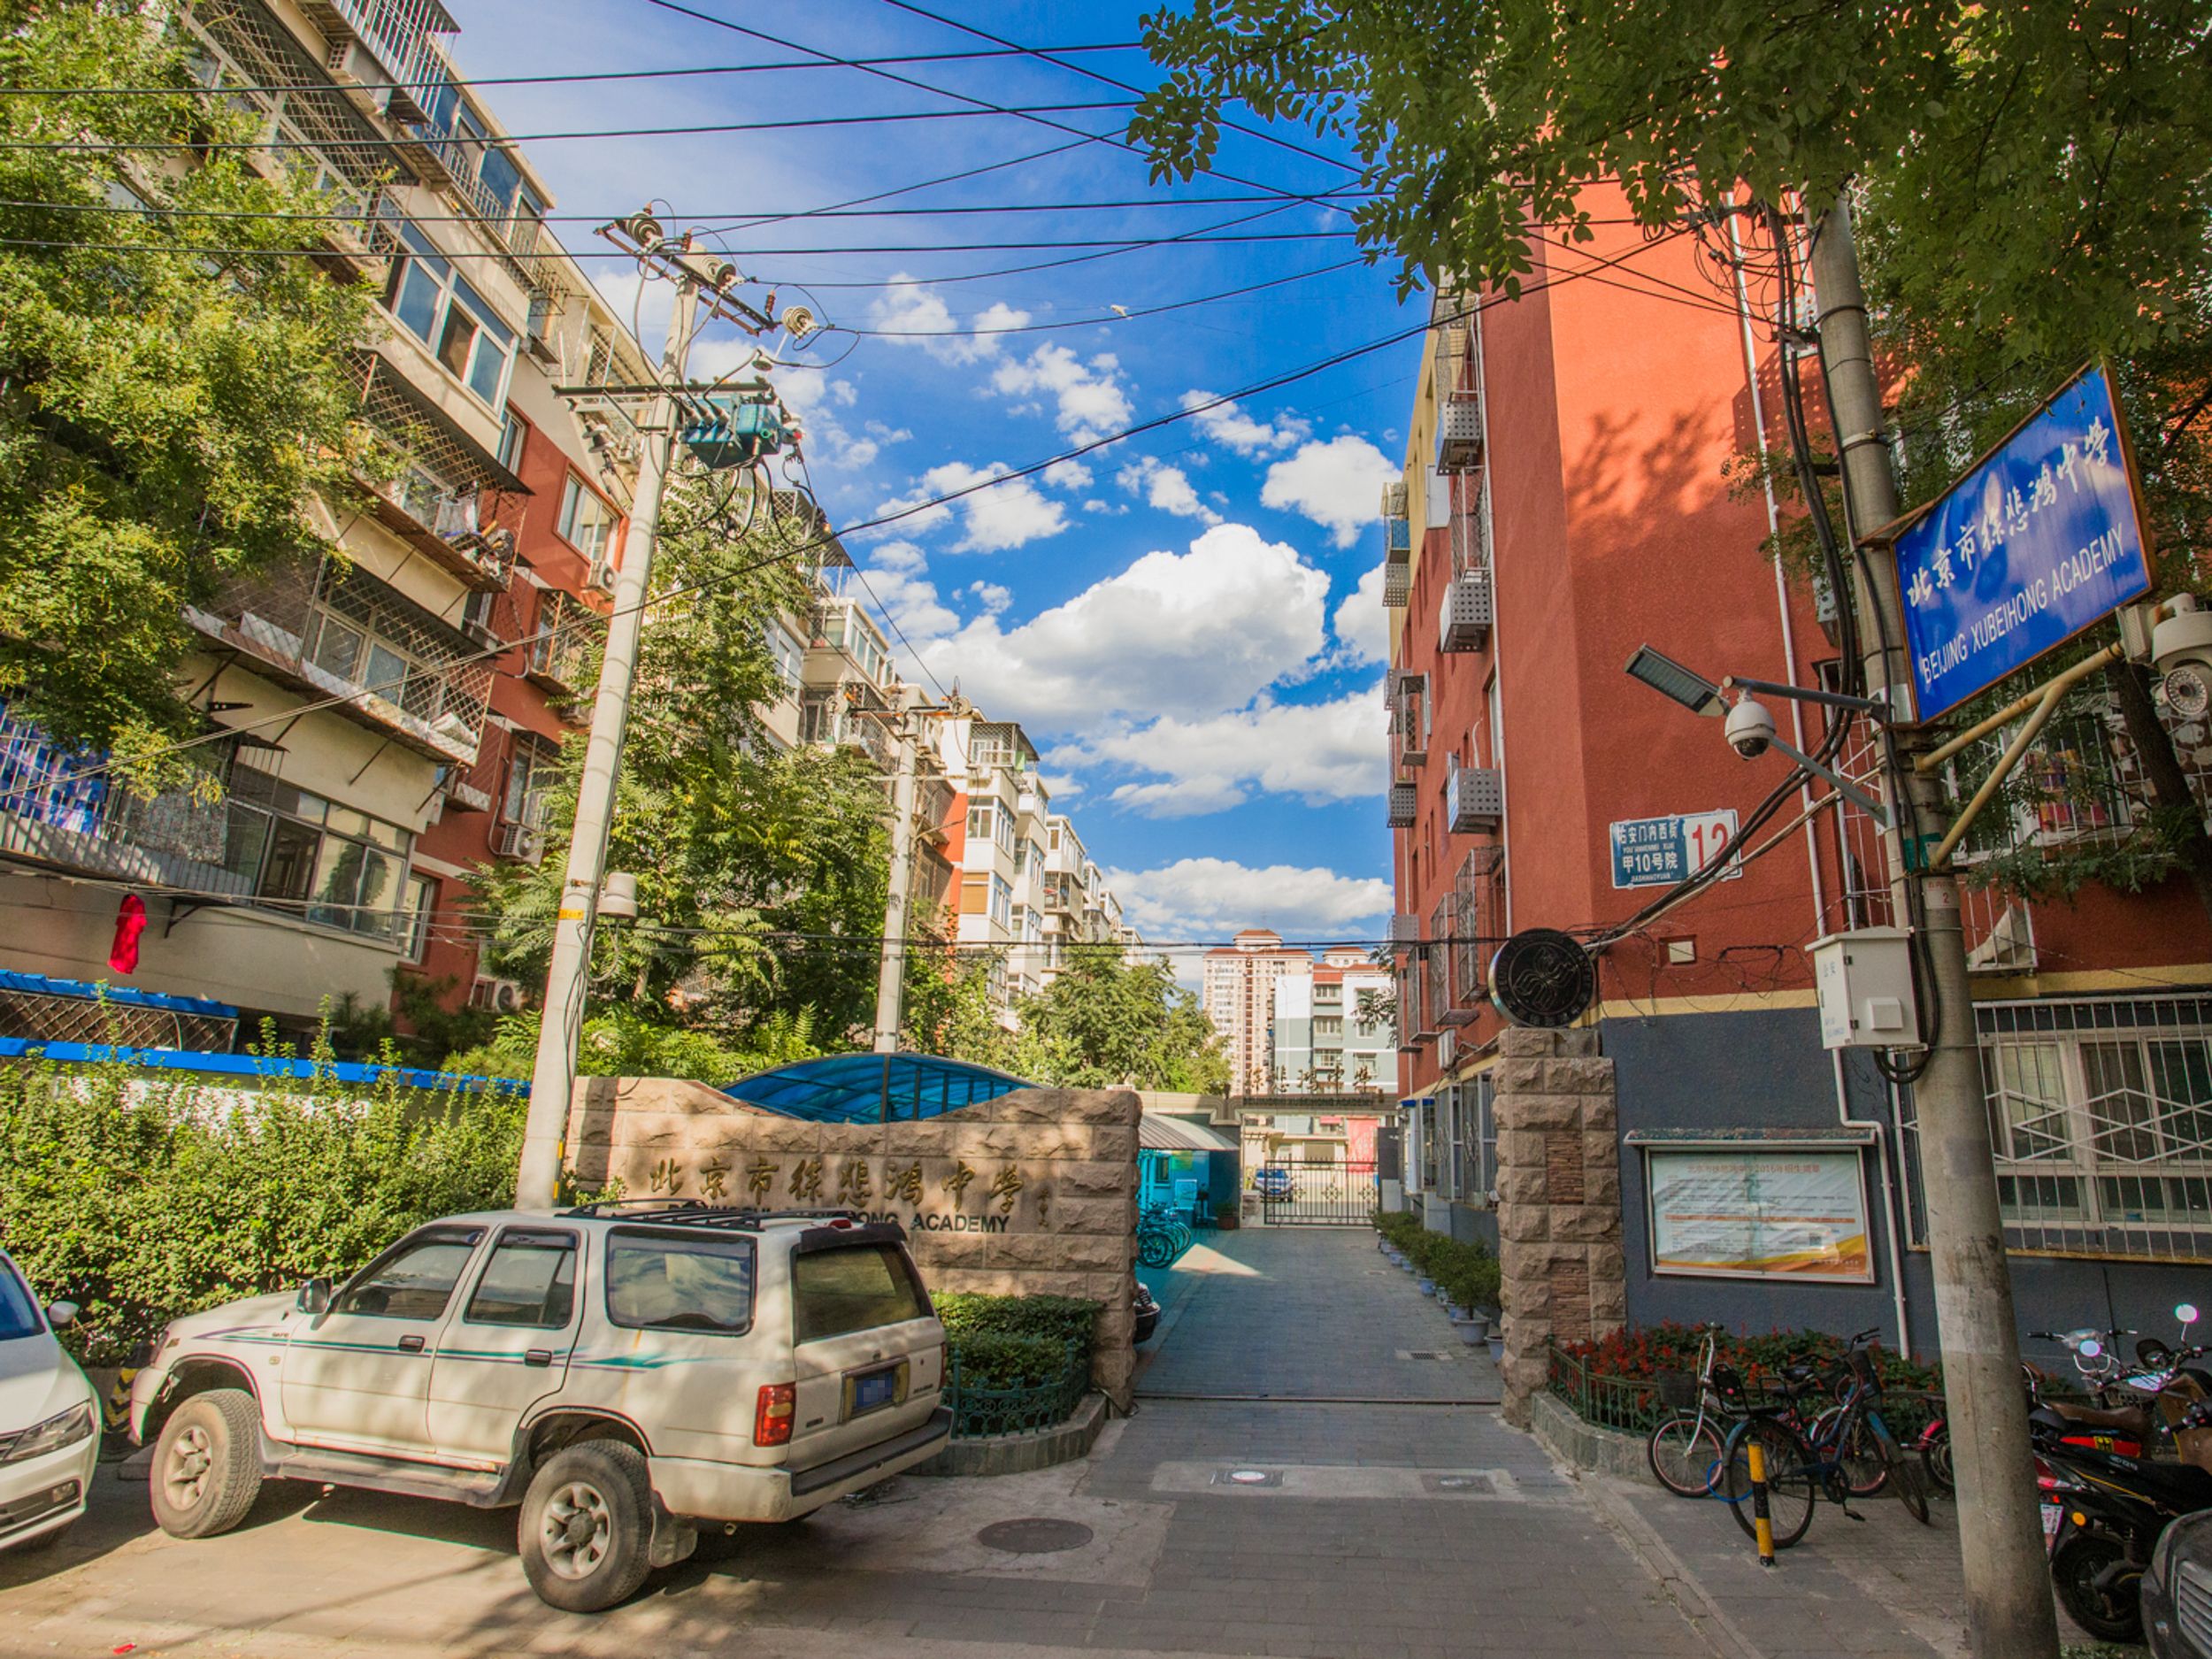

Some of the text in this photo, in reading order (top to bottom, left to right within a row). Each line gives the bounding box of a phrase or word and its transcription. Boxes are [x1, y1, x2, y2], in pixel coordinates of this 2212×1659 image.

[1922, 524, 2124, 685] BEIJING XUBEIHONG ACADEMY
[1623, 851, 1678, 873] 甲10号院
[1692, 823, 1730, 872] 12
[910, 1213, 1010, 1232] ACADEMY
